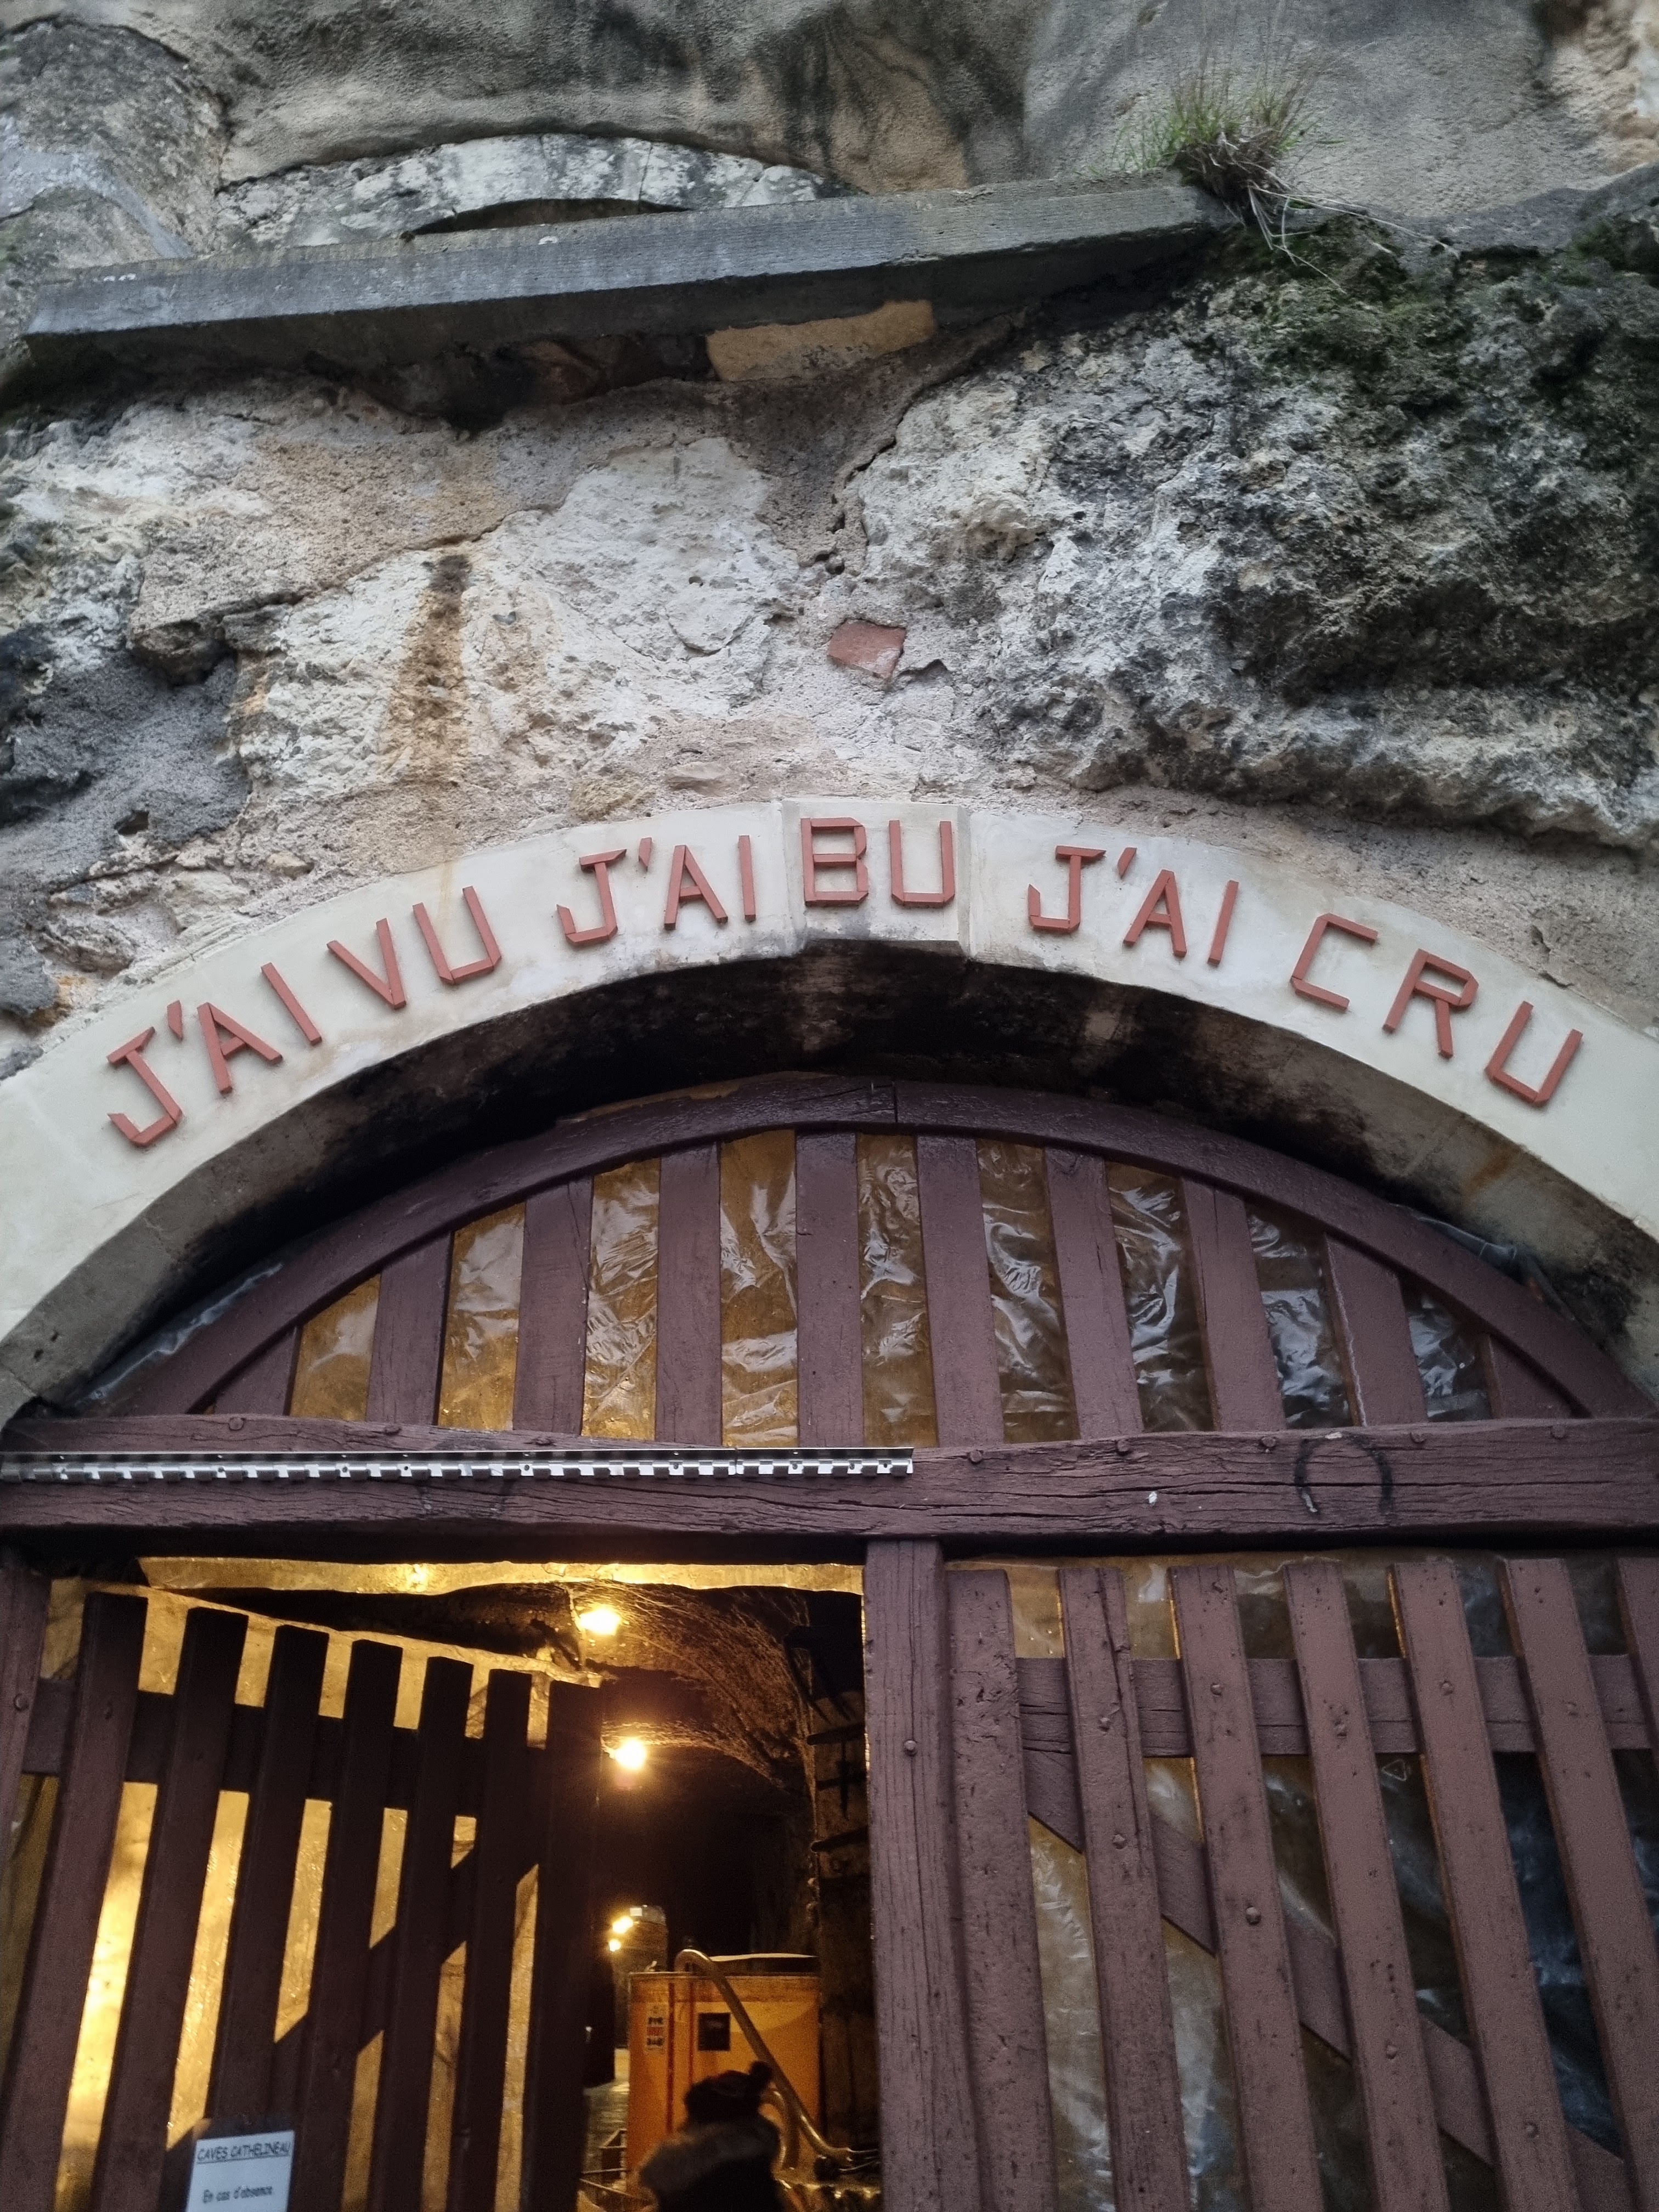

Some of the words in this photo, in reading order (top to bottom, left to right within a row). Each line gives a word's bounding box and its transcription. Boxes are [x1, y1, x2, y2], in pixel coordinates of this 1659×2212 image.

[106, 962, 323, 1147] J'AI
[326, 885, 503, 1009] VU
[556, 835, 757, 947] J'AI
[800, 817, 956, 908] BU
[1028, 845, 1239, 966] J'AI
[1289, 913, 1583, 1107] CRU
[197, 2146, 228, 2162] CAVES
